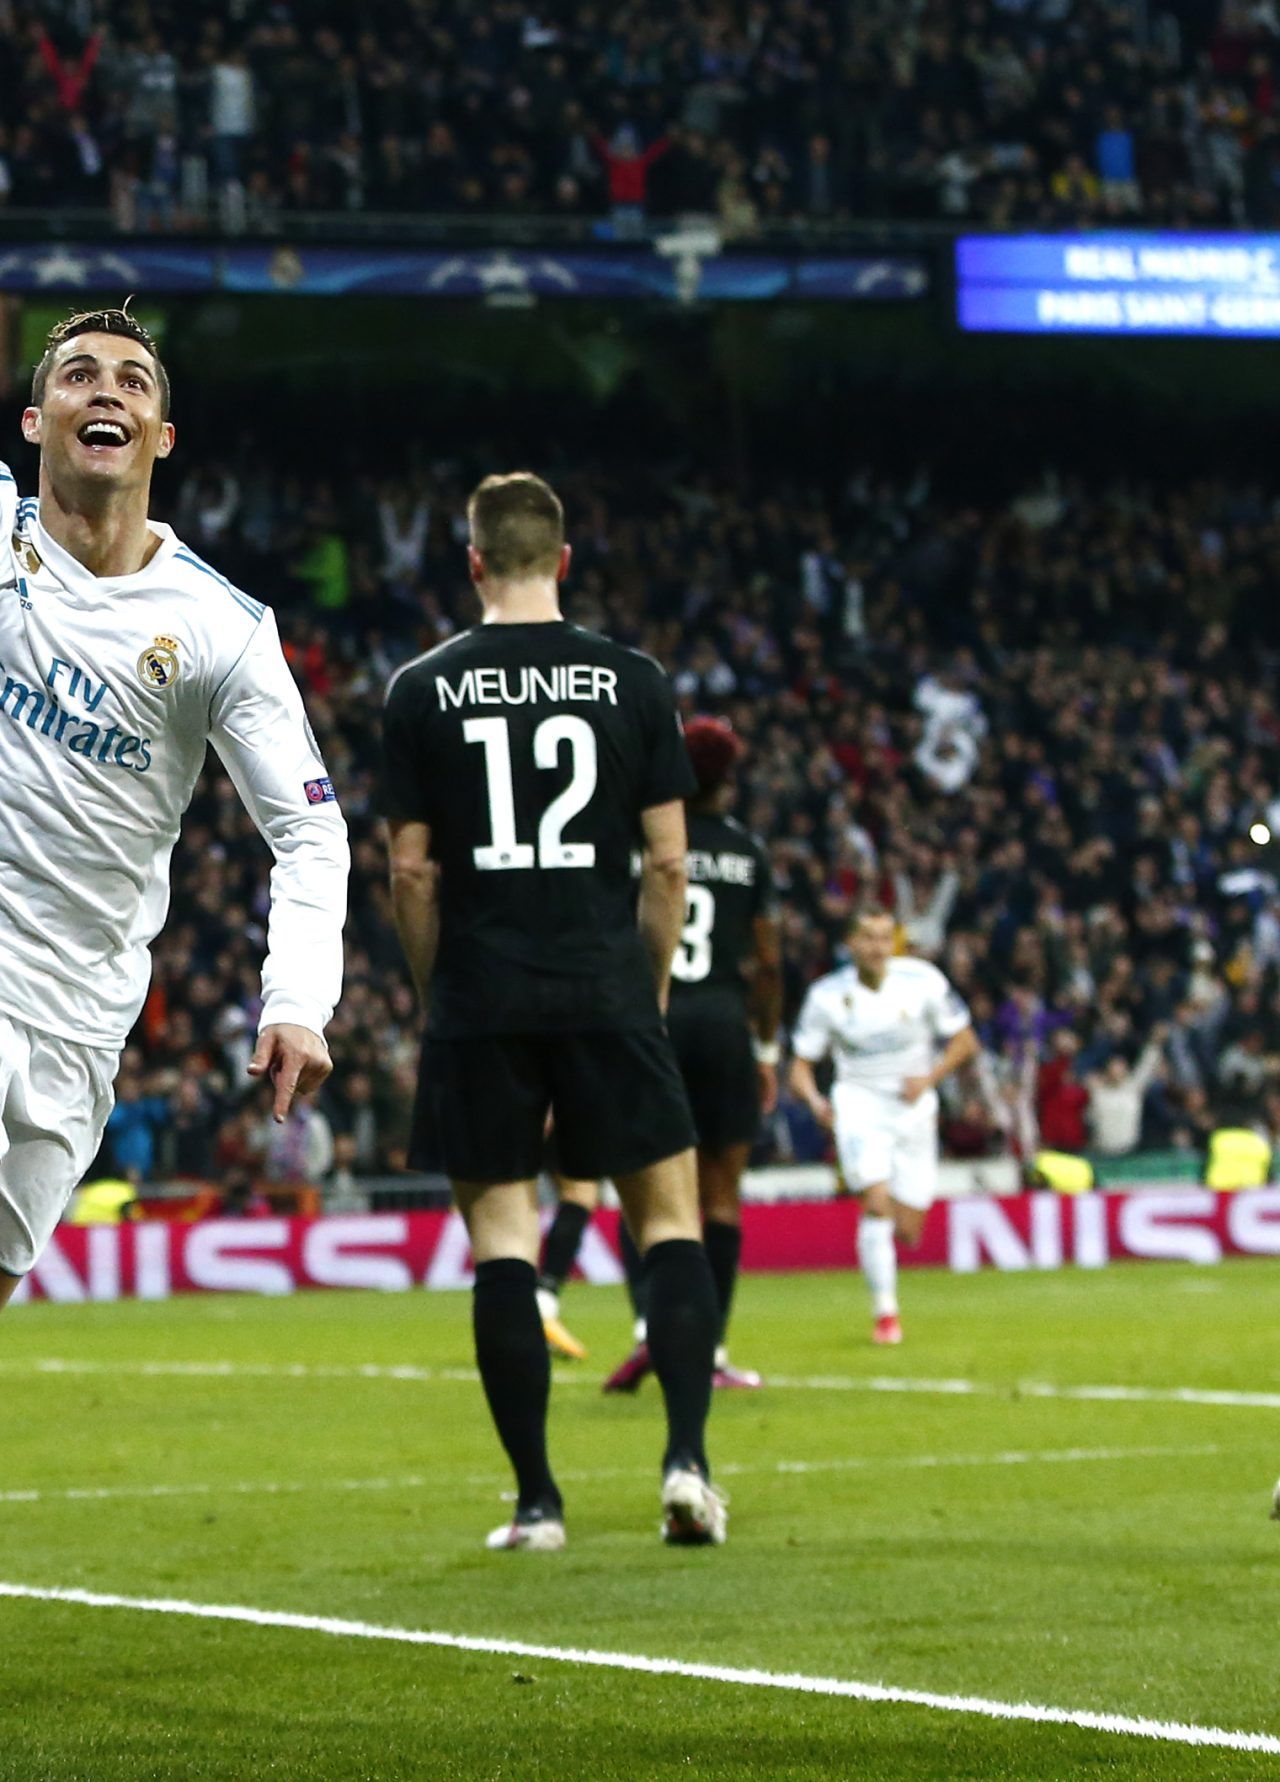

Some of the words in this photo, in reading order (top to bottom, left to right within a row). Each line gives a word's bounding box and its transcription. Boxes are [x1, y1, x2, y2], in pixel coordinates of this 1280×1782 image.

[46, 656, 110, 712] Fly
[435, 663, 619, 711] MEUNIER
[462, 713, 598, 871] 12
[670, 883, 716, 982] 3
